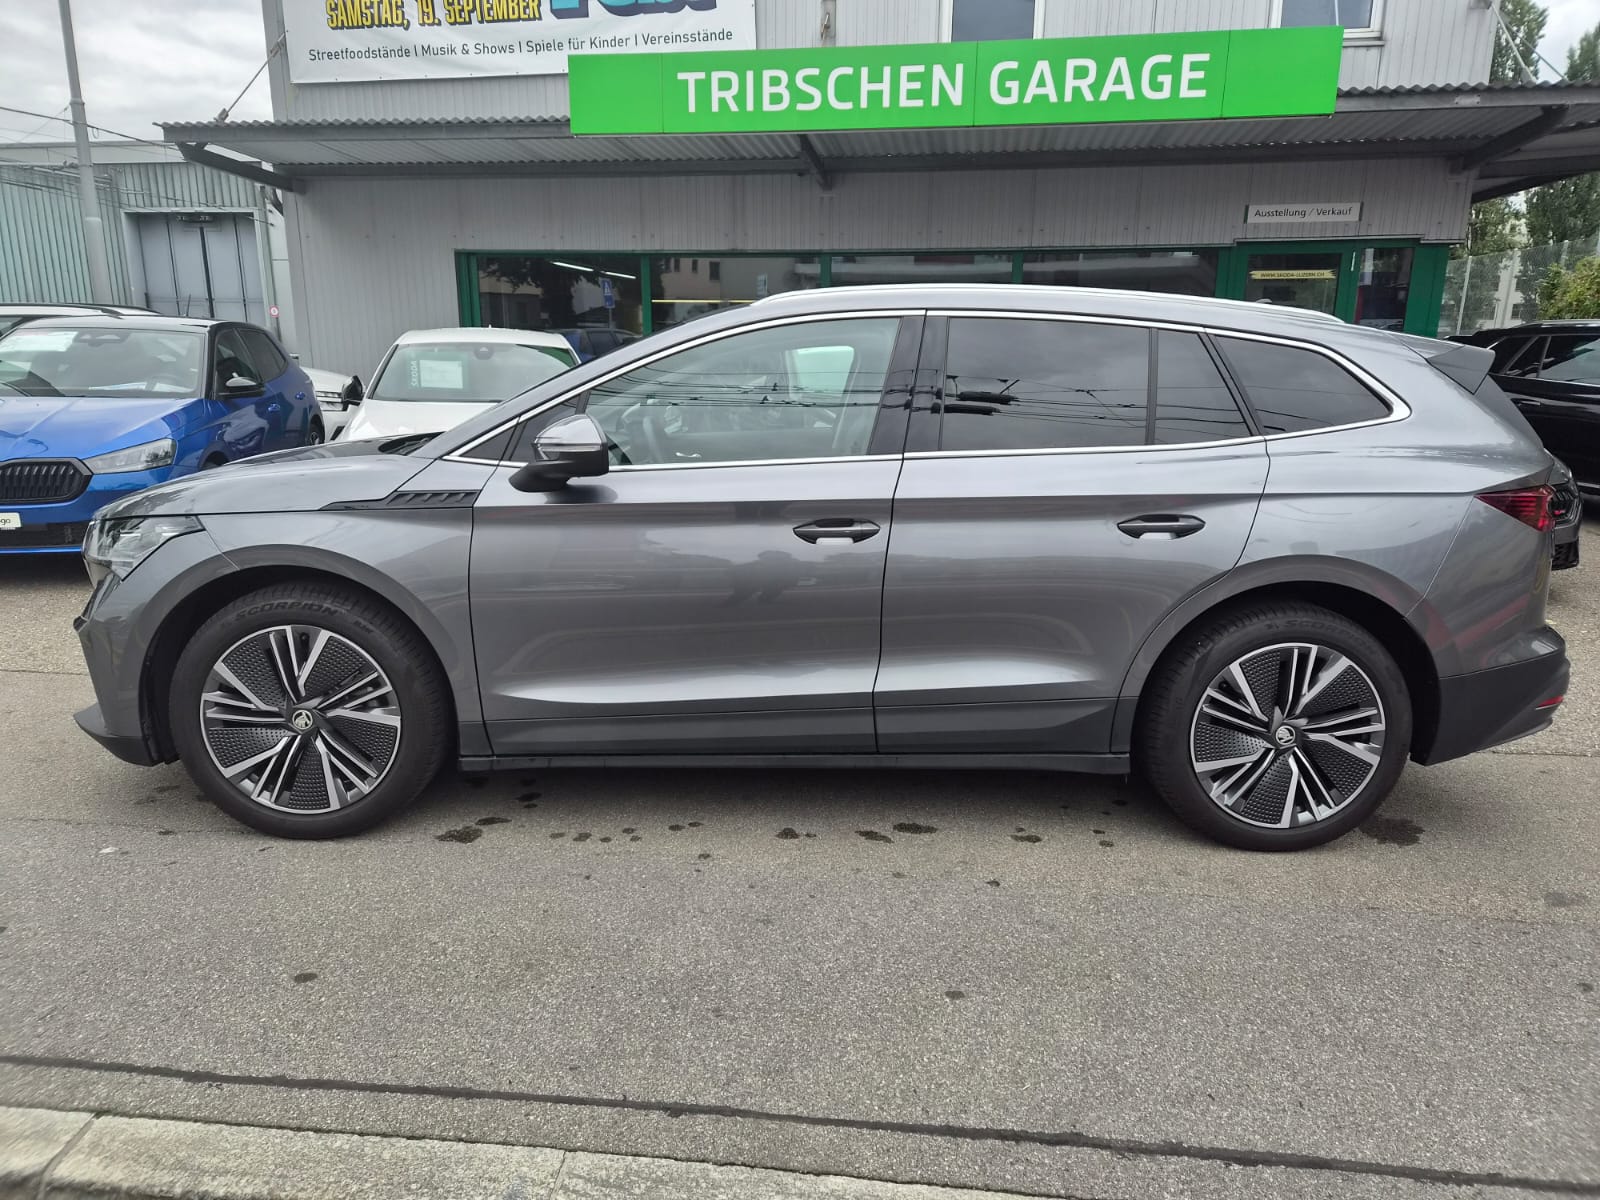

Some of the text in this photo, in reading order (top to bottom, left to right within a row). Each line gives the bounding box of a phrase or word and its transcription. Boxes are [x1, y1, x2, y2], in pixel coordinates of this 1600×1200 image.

[326, 0, 410, 30] SAMSTAG,
[417, 0, 441, 26] 19.
[444, 0, 543, 25] SEPTEMBER
[308, 45, 411, 61] Streetfoodstände
[421, 43, 457, 57] Musik
[461, 43, 470, 55] &
[474, 42, 515, 55] Shows
[526, 38, 564, 55] Spiele
[568, 37, 586, 50] für
[589, 33, 630, 49] Kinder
[641, 28, 733, 45] Vereinsstände
[677, 53, 1211, 113] TRIBSCHEN GARAGE
[1254, 208, 1307, 219] Ausstellung
[1316, 206, 1353, 216] Verkauf
[234, 601, 339, 621] SCORPION
